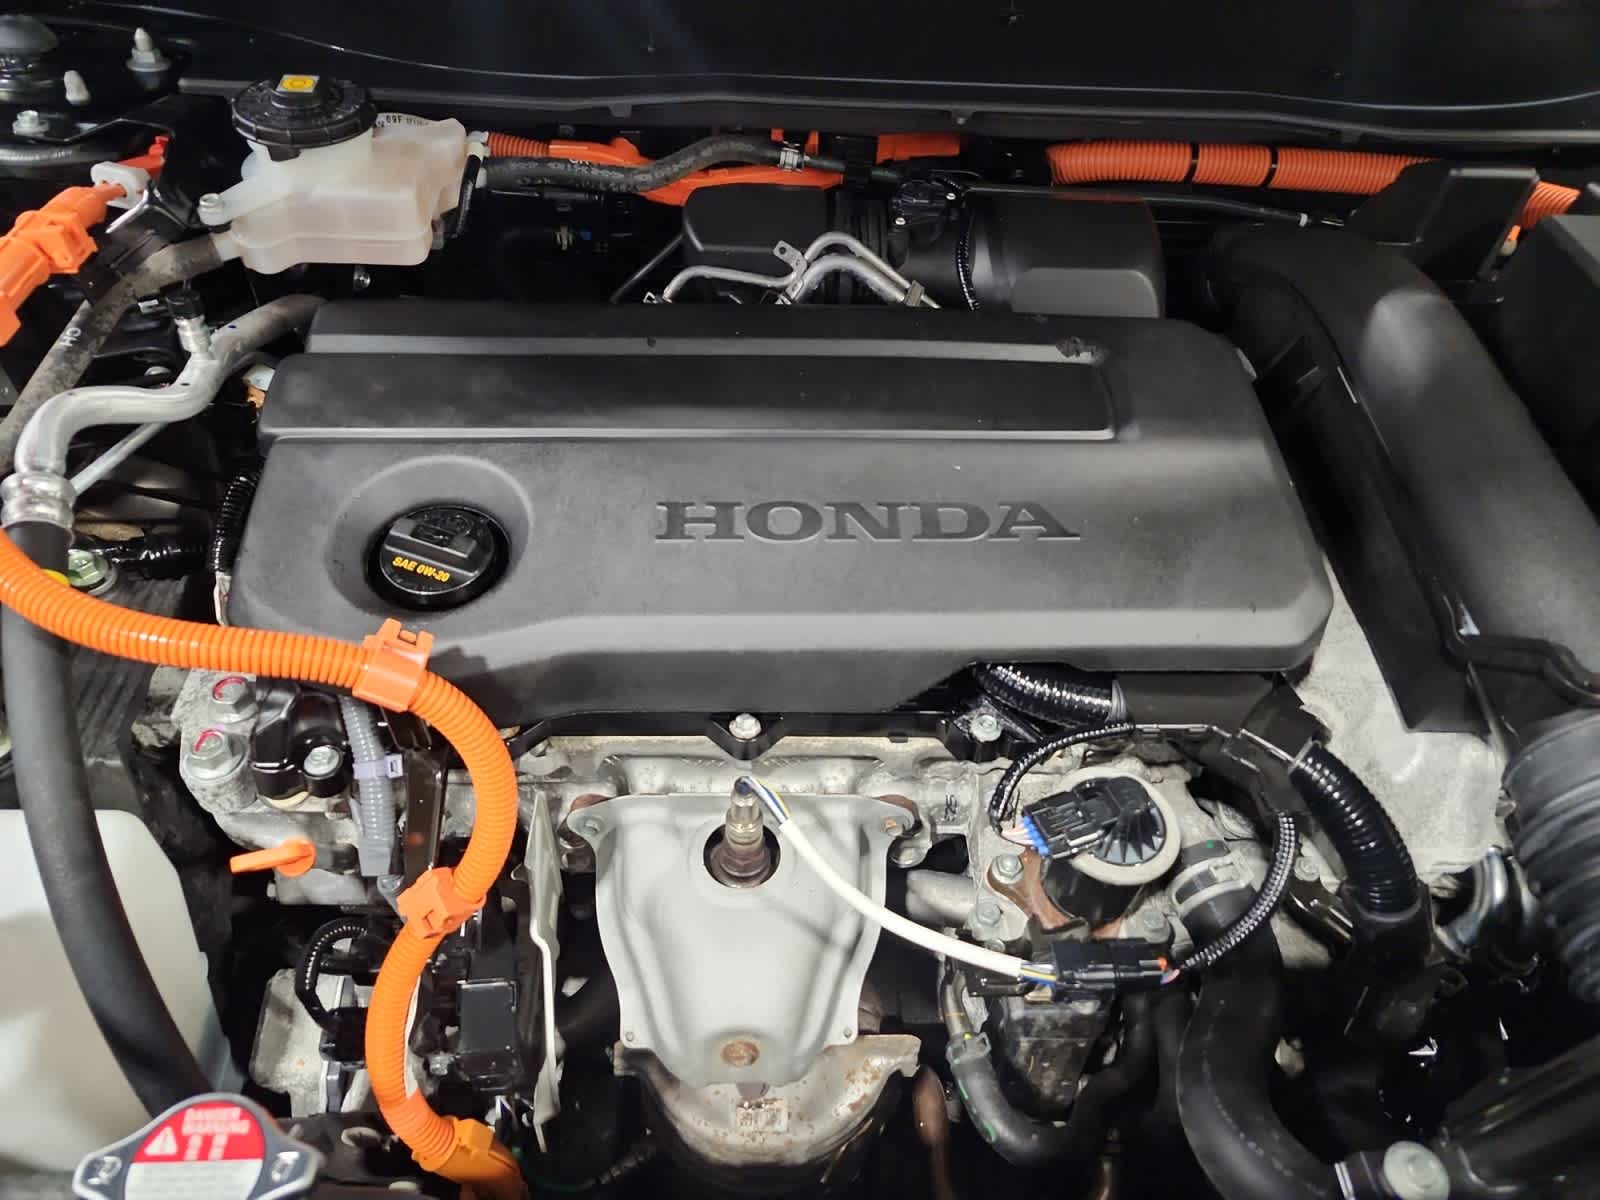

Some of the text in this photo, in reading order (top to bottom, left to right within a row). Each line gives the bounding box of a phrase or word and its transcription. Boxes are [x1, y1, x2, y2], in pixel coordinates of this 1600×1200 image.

[655, 501, 1080, 543] HONDA
[392, 556, 450, 582] SAE 0W-20
